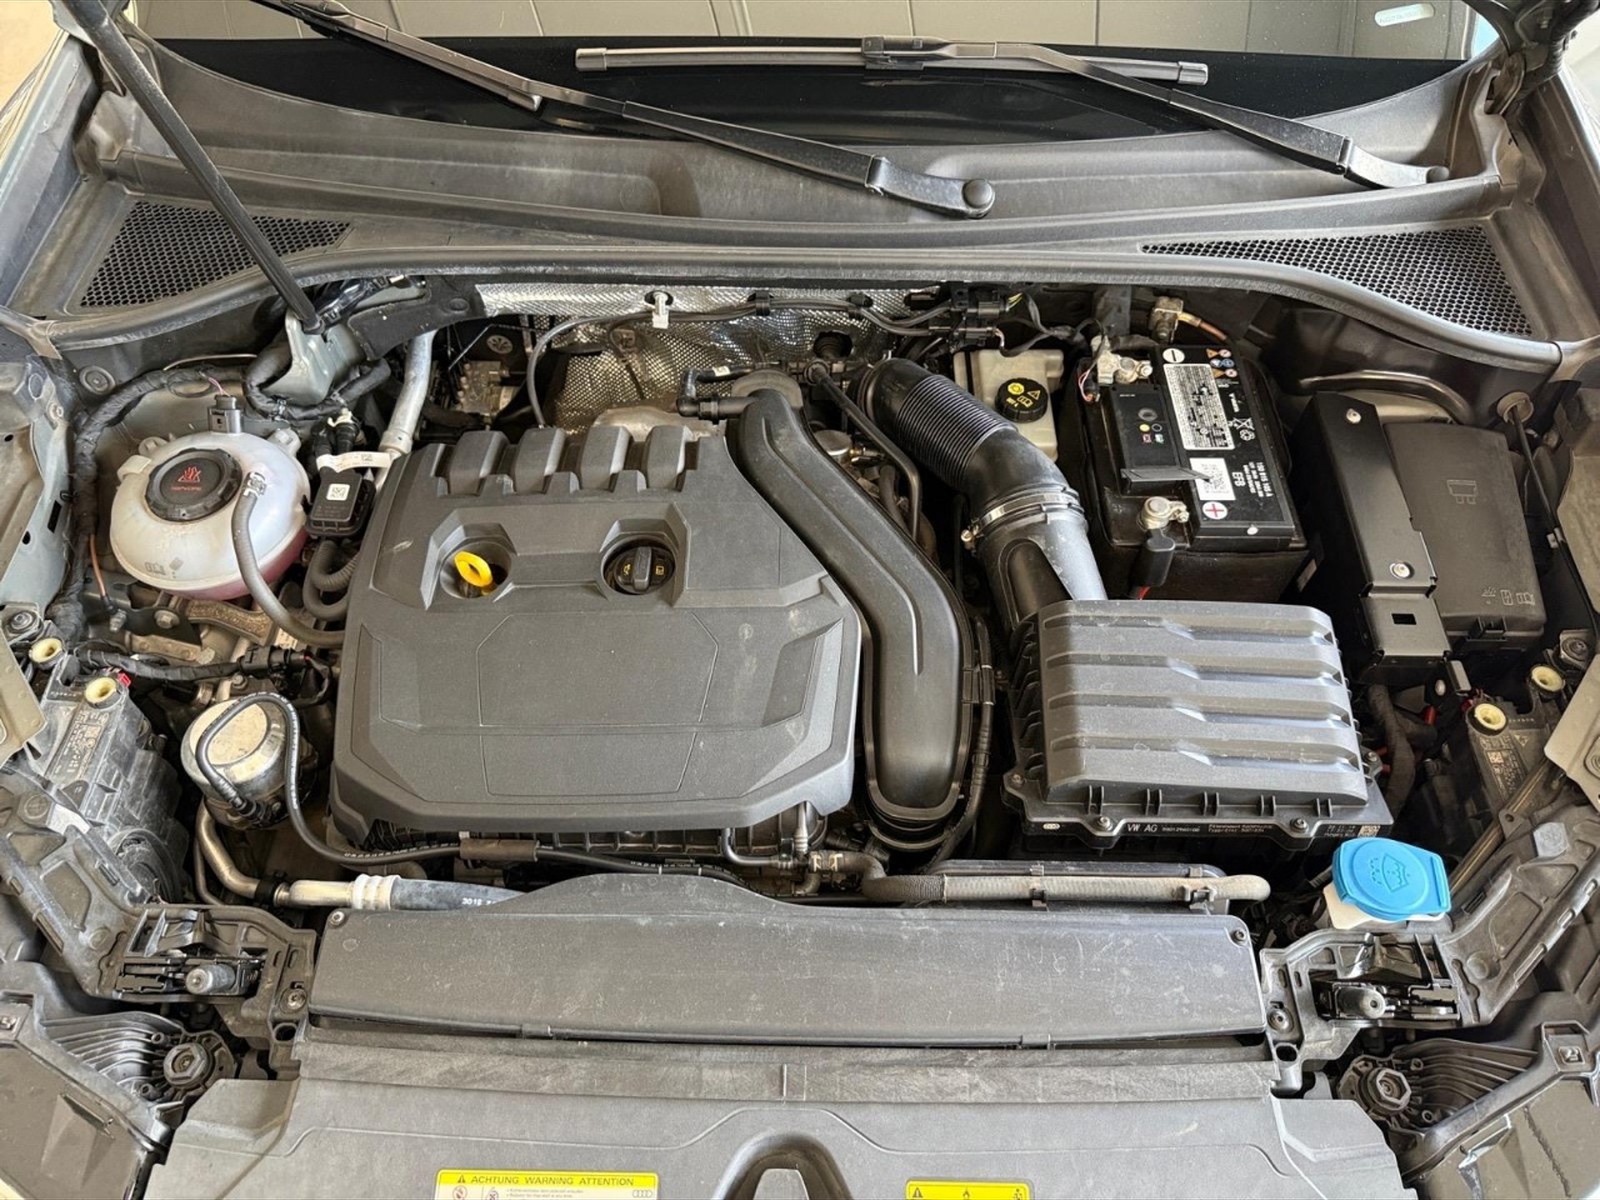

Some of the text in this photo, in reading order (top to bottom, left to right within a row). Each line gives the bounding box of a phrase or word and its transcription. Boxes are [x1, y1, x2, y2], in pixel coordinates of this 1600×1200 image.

[1231, 471, 1246, 487] EFB
[1127, 823, 1140, 832] VW
[1143, 823, 1158, 833] AG
[471, 1175, 634, 1186] ACHTUNG WARNING ATTENTION
